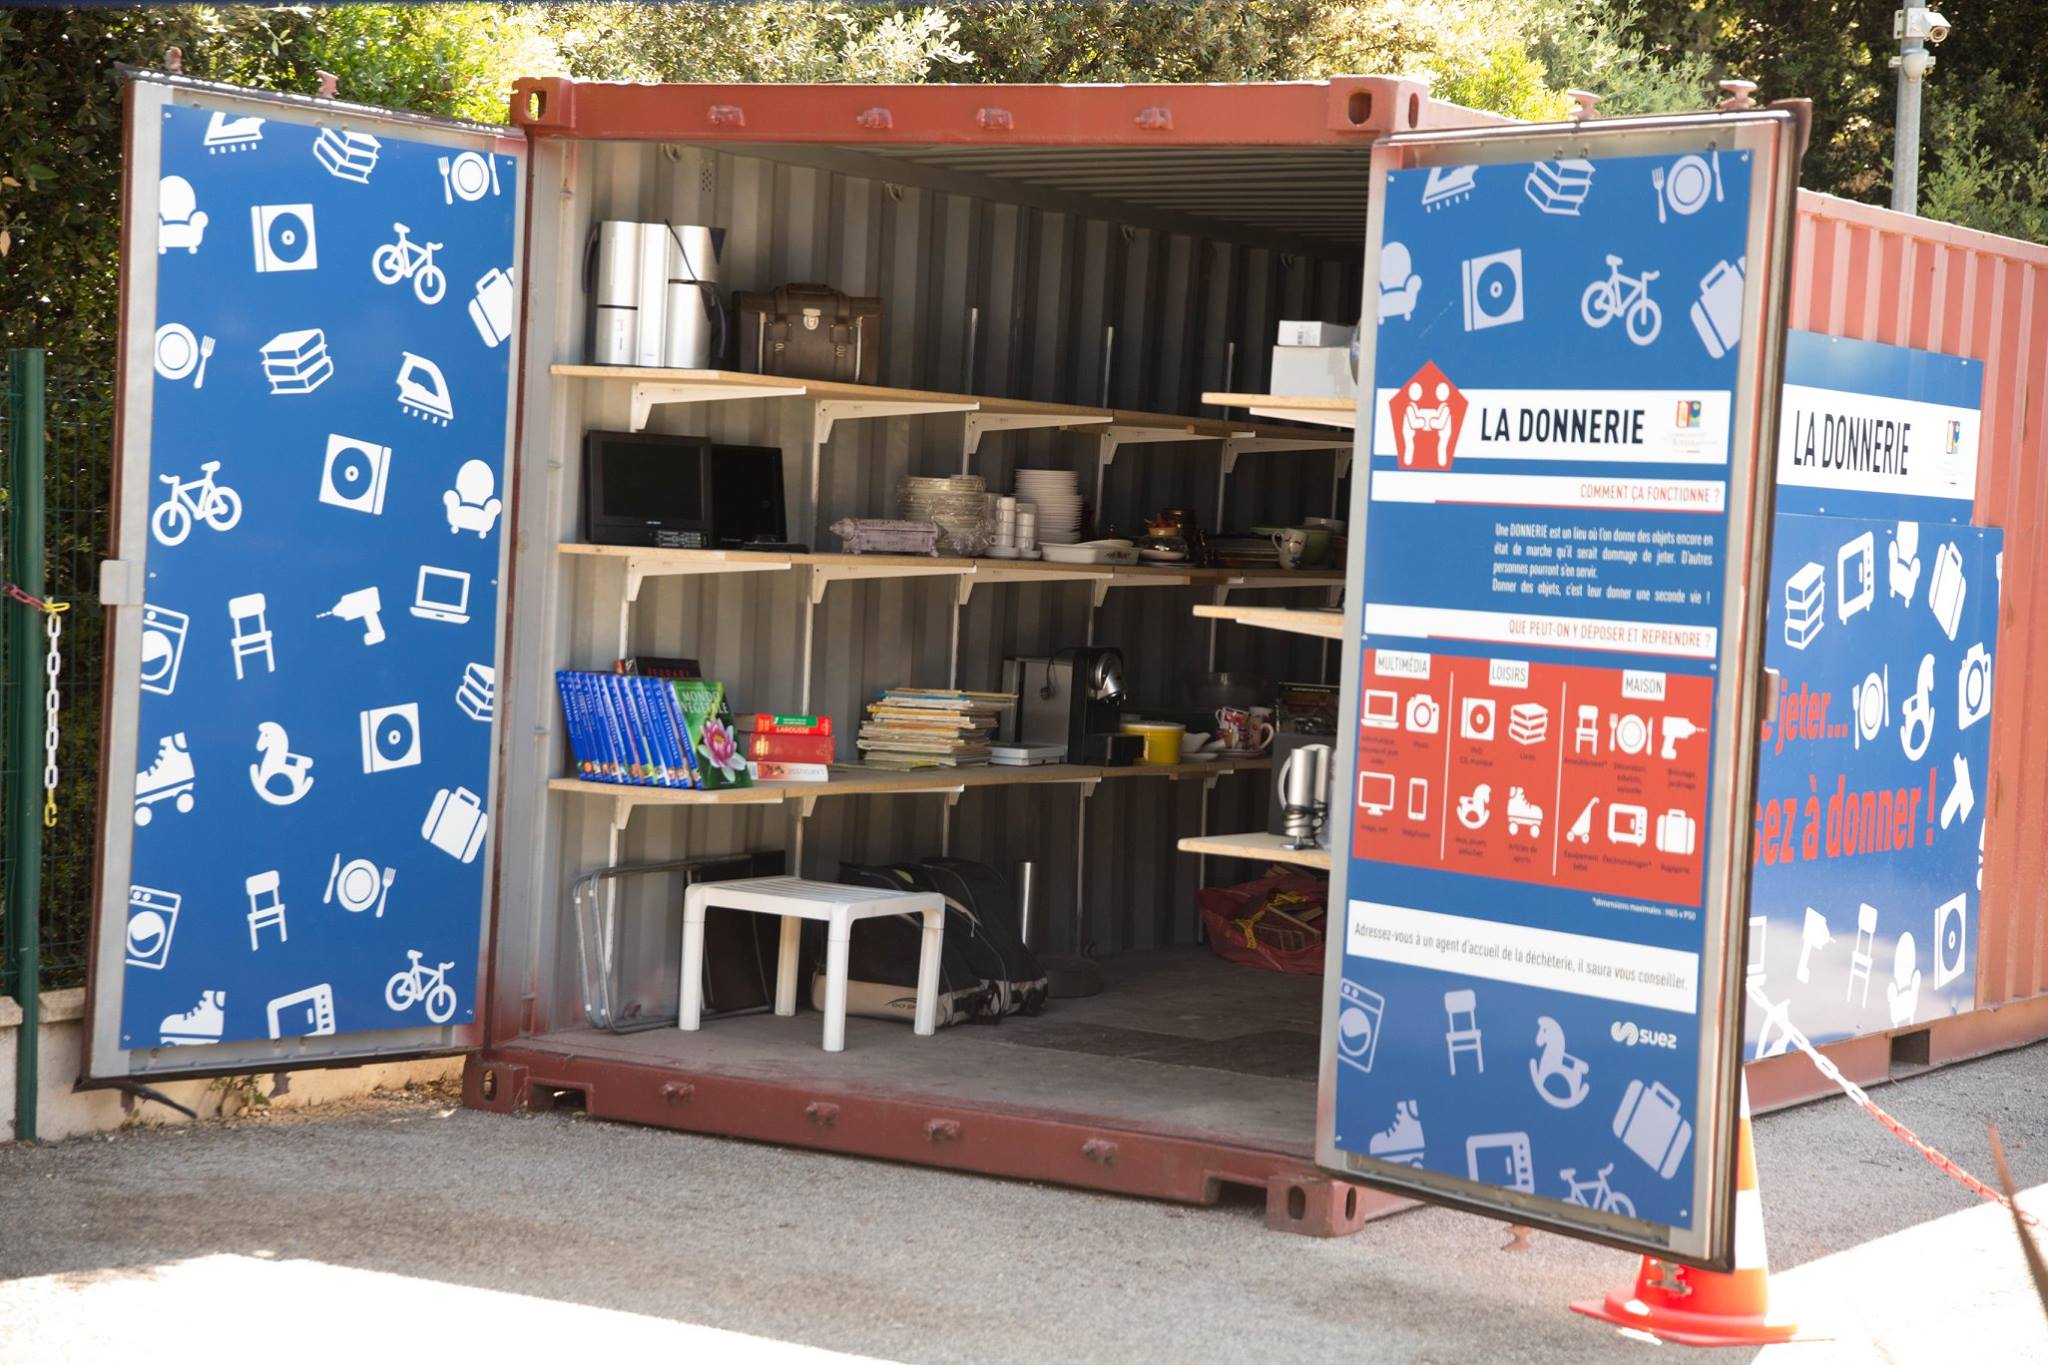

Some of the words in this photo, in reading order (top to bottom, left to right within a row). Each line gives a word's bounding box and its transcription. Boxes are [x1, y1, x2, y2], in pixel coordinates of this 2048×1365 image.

[1481, 408, 1510, 441] LA
[1519, 408, 1645, 444] DONNERIE
[1794, 410, 1815, 467] LA
[1822, 413, 1910, 475] DONNERIE
[1581, 485, 1628, 499] COMMENT
[1632, 486, 1644, 503] ÇA
[1648, 486, 1710, 503] FONCTIONNE
[1714, 488, 1720, 502] ?
[1495, 523, 1509, 537] Une
[1510, 523, 1547, 538] DONNERIE
[1550, 525, 1561, 538] est
[1562, 528, 1571, 539] un
[1573, 527, 1586, 540] lieu
[1588, 528, 1598, 540] où
[1614, 529, 1636, 542] donne
[1637, 530, 1650, 543] des
[1652, 530, 1675, 547] objets
[1676, 533, 1701, 545] encore
[1703, 534, 1713, 546] en
[1494, 542, 1508, 555] état
[1513, 543, 1521, 556] de
[1526, 544, 1552, 557] marche
[1557, 545, 1572, 561] qu'il
[1577, 546, 1597, 559] serait
[1602, 548, 1637, 564] dommage
[1643, 551, 1652, 563] de
[1656, 551, 1676, 566] jeter.
[1681, 552, 1712, 565] D'autres
[1493, 562, 1528, 576] personnes
[1530, 564, 1559, 577] pourront
[1560, 564, 1574, 576] s'en
[1576, 566, 1598, 578] servir.
[1492, 578, 1516, 592] Donner
[1521, 580, 1533, 593] des
[1538, 581, 1561, 597] objets,
[1566, 583, 1582, 596] c'est
[1587, 584, 1601, 597] leur
[1606, 585, 1631, 598] donner
[1636, 588, 1650, 600] une
[1655, 589, 1685, 603] seconde
[1690, 591, 1701, 604] vie
[1509, 620, 1526, 634] QUE
[1530, 621, 1569, 637] PEUT-ON
[1573, 625, 1579, 638] Y
[1581, 623, 1624, 641] DÉPOSER
[1627, 628, 1637, 642] ET
[1642, 629, 1701, 647] REPRENDRE
[1705, 634, 1711, 647] ?
[1378, 656, 1428, 673] MULTIMÉDIA
[1492, 666, 1526, 682] LOISIRS
[1625, 678, 1663, 693] MAISON
[1775, 678, 1848, 756] jeter...
[1803, 774, 1820, 861] à
[1826, 774, 1921, 858] donner
[1926, 767, 1936, 846] !
[1354, 923, 1414, 946] Adressez-vous
[1416, 931, 1420, 946] à
[1424, 935, 1434, 949] un
[1436, 937, 1459, 955] agent
[1461, 940, 1500, 959] d'accueil
[1502, 948, 1512, 961] de
[1515, 950, 1523, 963] la
[1578, 956, 1585, 973] il
[1587, 960, 1612, 977] saura
[1615, 967, 1635, 982] vous
[1638, 969, 1687, 990] conseiller.
